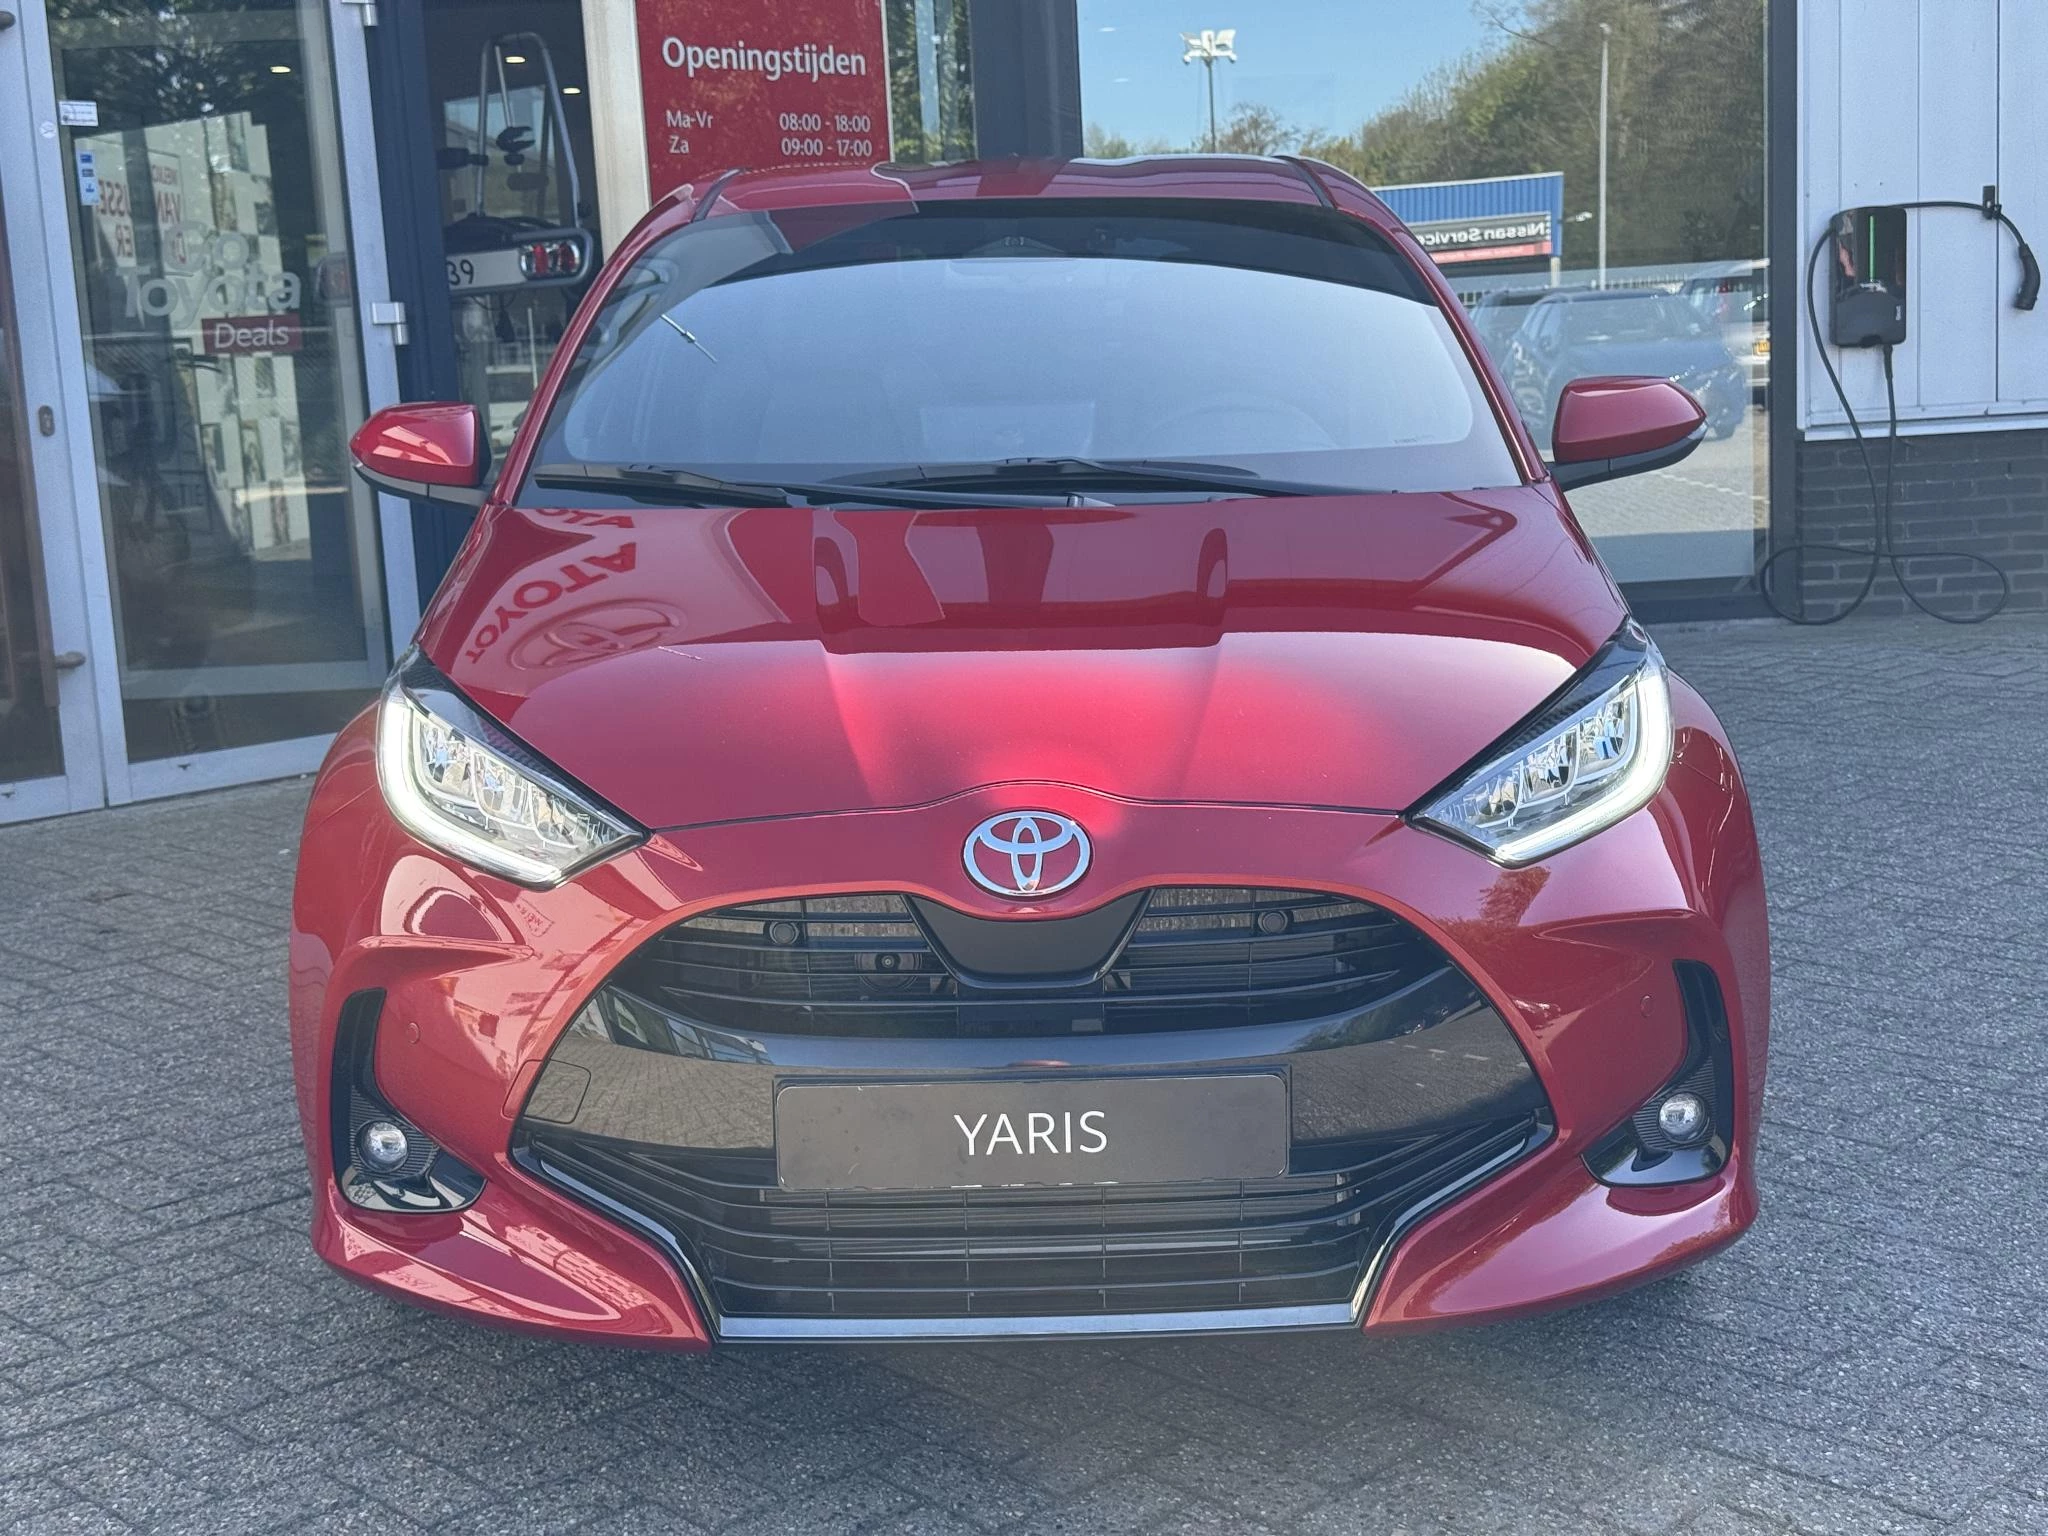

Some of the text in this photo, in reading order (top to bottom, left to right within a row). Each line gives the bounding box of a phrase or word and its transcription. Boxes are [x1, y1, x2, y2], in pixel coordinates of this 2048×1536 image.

[662, 36, 866, 83] Openingstijden
[666, 110, 714, 129] Ma-Vr
[779, 113, 821, 131] 08:00
[834, 114, 871, 133] 18:00
[669, 134, 690, 154] Za
[781, 138, 823, 156] 09:00
[836, 139, 872, 157] 17:00
[116, 262, 302, 330] Toyota
[213, 320, 290, 349] Deals
[953, 1110, 1108, 1156] YARIS
